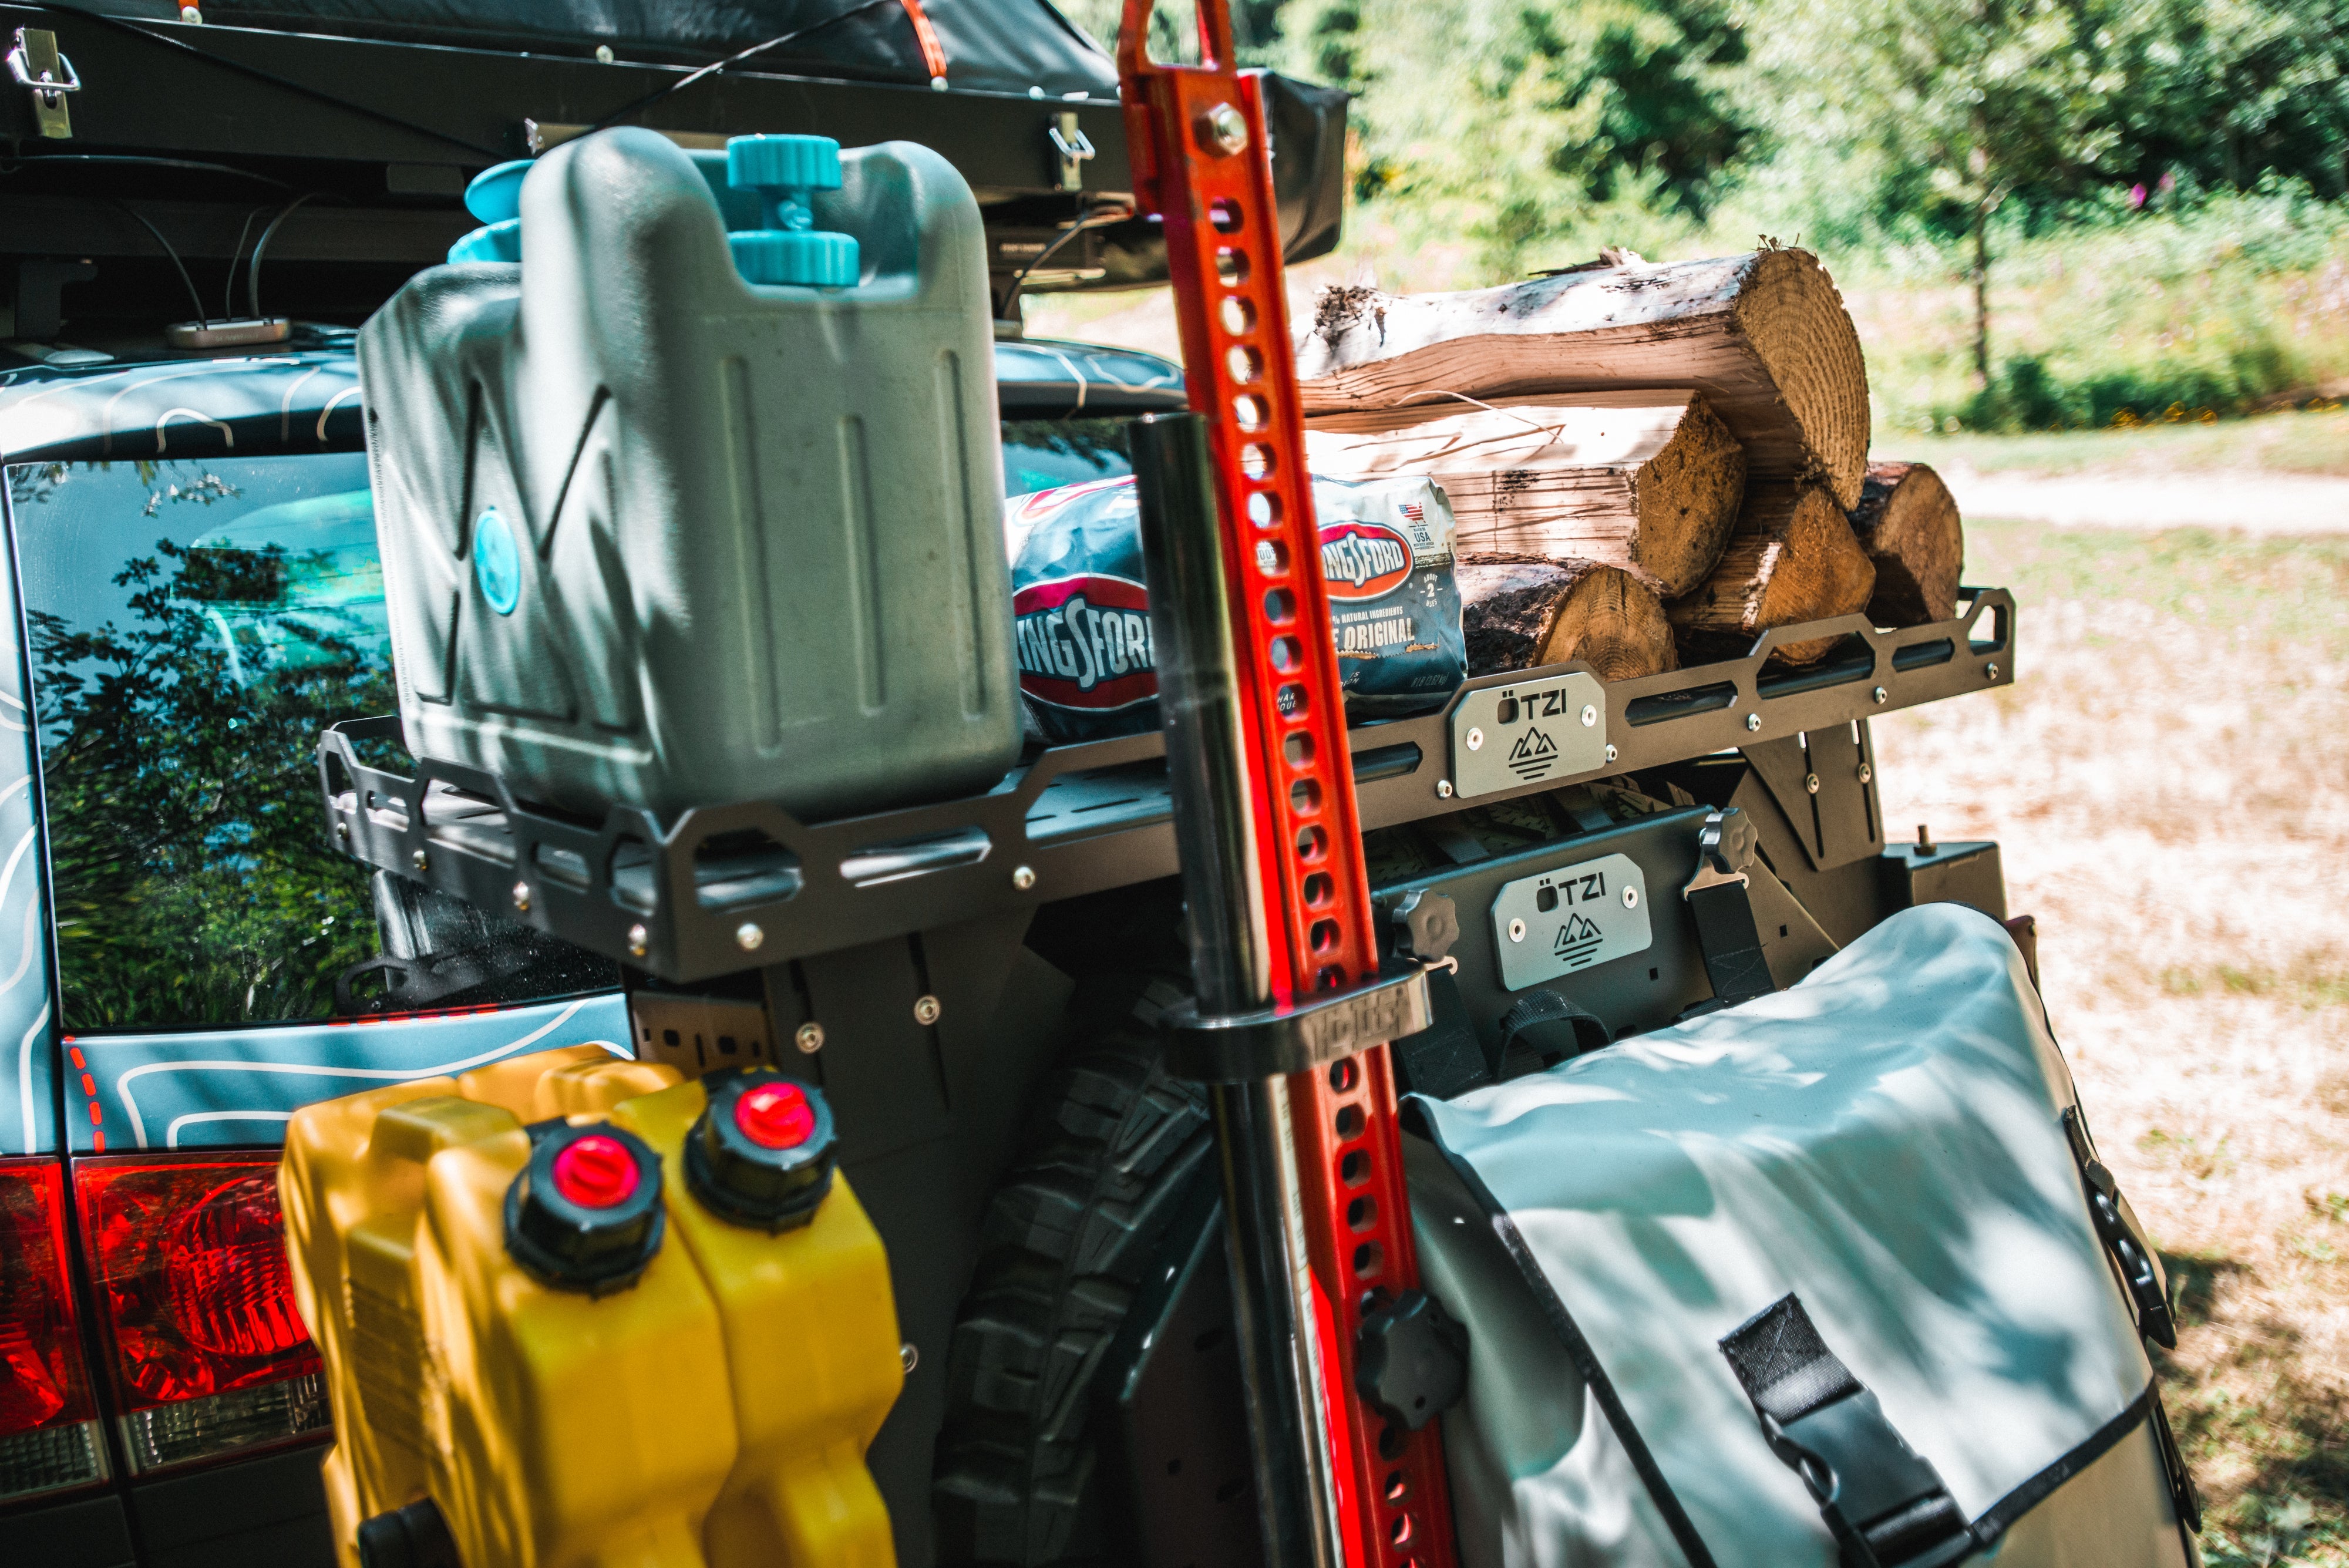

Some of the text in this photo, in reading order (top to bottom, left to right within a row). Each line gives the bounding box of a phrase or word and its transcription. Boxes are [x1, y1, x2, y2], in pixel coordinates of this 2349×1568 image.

[1414, 531, 1431, 543] USA
[1423, 573, 1438, 584] ABOUT
[1427, 583, 1435, 598] 2
[1426, 598, 1438, 608] USES
[1341, 611, 1369, 623] NATURAL
[1369, 606, 1404, 619] INGREDIENTS
[1344, 617, 1415, 651] ORIGINAL
[1017, 598, 1155, 688] INGSFOR
[1497, 688, 1567, 725] ÖTZI
[1536, 872, 1606, 913] ÖTZI
